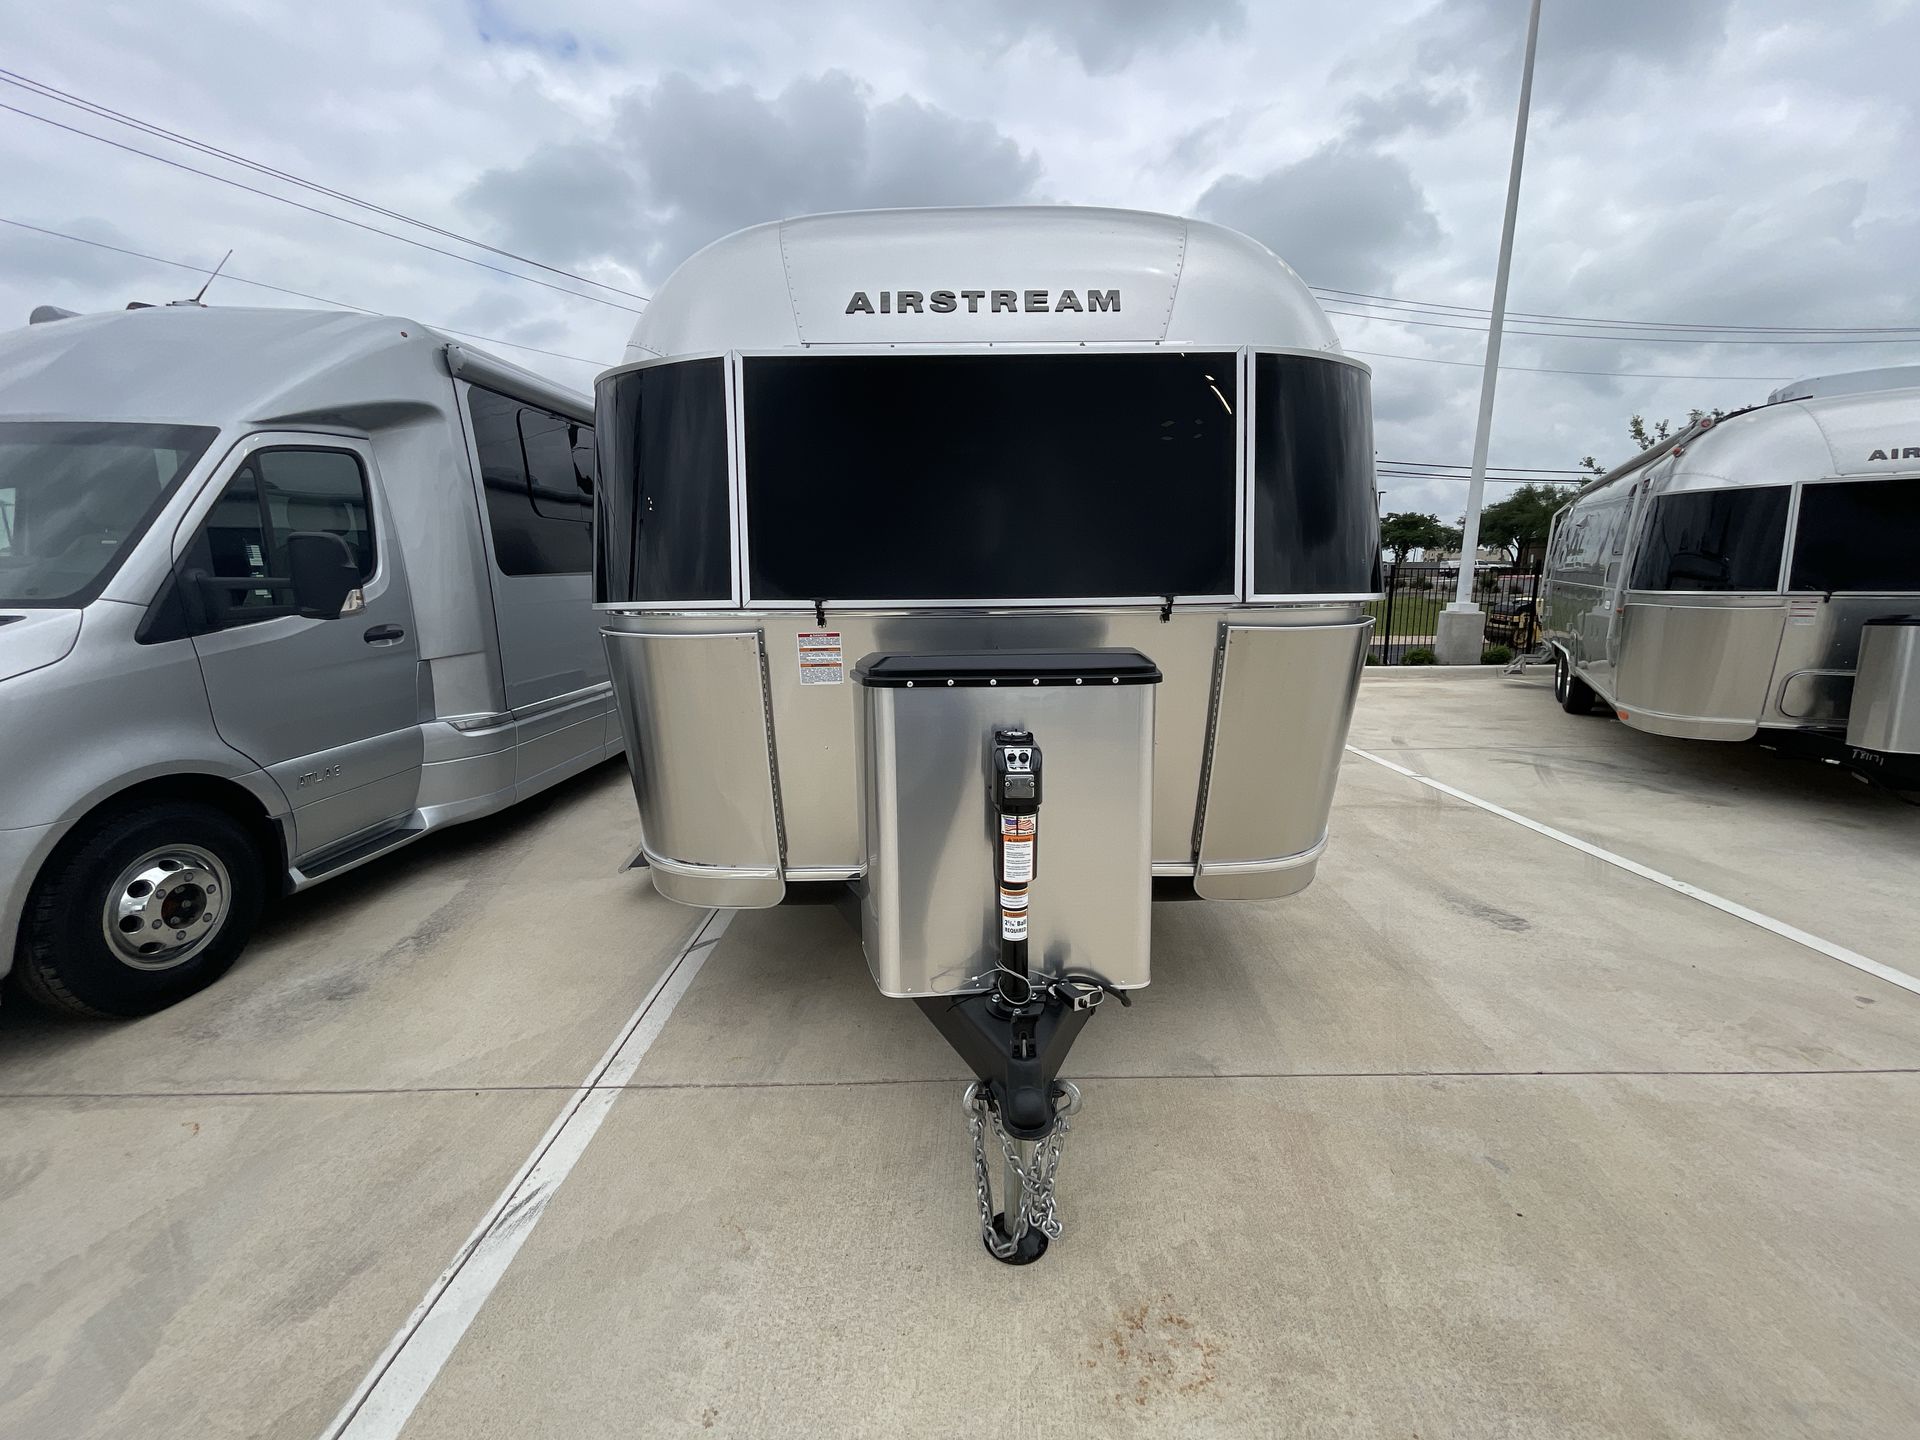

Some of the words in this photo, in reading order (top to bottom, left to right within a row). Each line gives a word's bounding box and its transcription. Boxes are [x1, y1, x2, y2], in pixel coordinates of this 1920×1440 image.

[845, 289, 1121, 314] AIRSTREAM
[296, 764, 341, 790] ATLAS
[1004, 926, 1027, 934] REQUIRED
